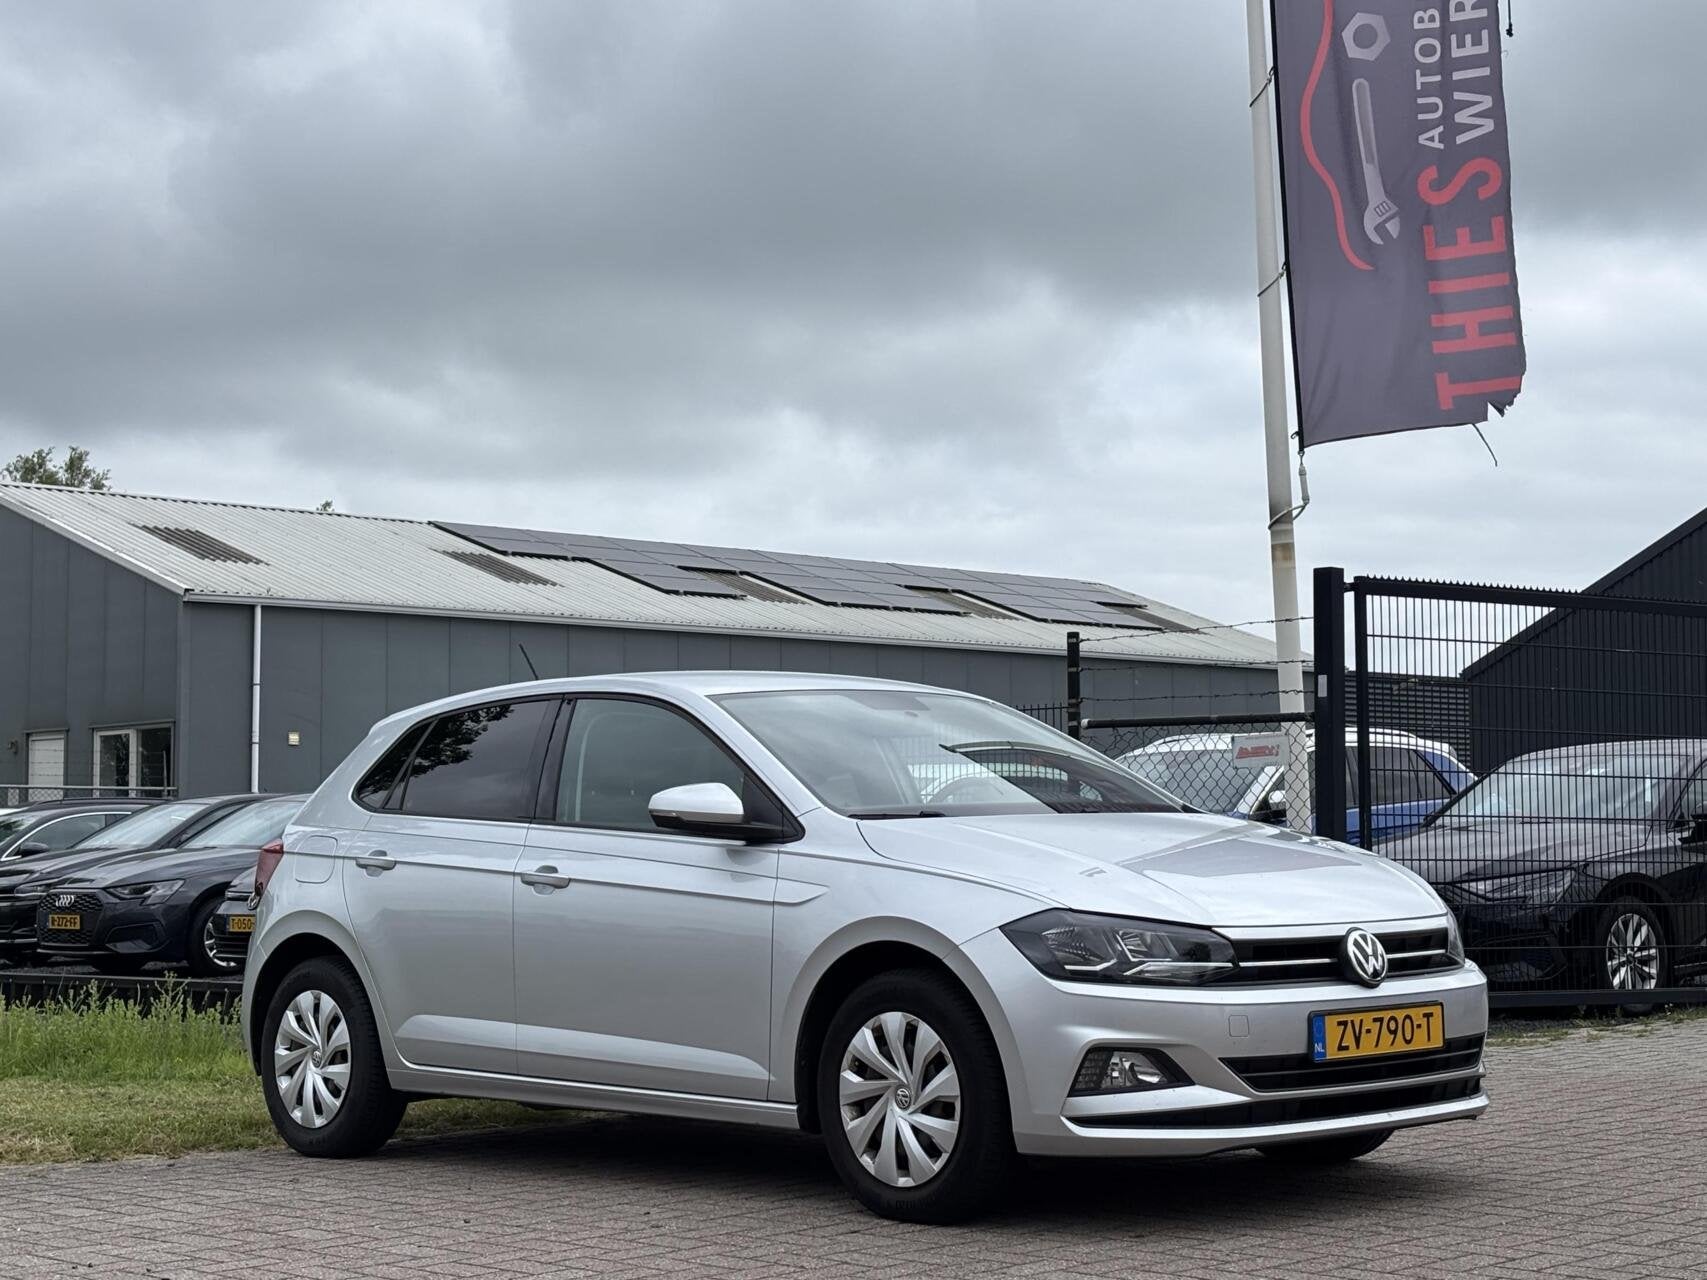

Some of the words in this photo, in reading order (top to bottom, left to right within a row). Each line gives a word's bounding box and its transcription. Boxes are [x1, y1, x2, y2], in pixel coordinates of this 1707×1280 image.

[1413, 8, 1444, 150] AUTOB
[1449, 0, 1495, 145] WIER
[1417, 157, 1522, 411] THIES
[1314, 1042, 1325, 1053] NL
[1336, 1012, 1434, 1051] ZV-790-T
